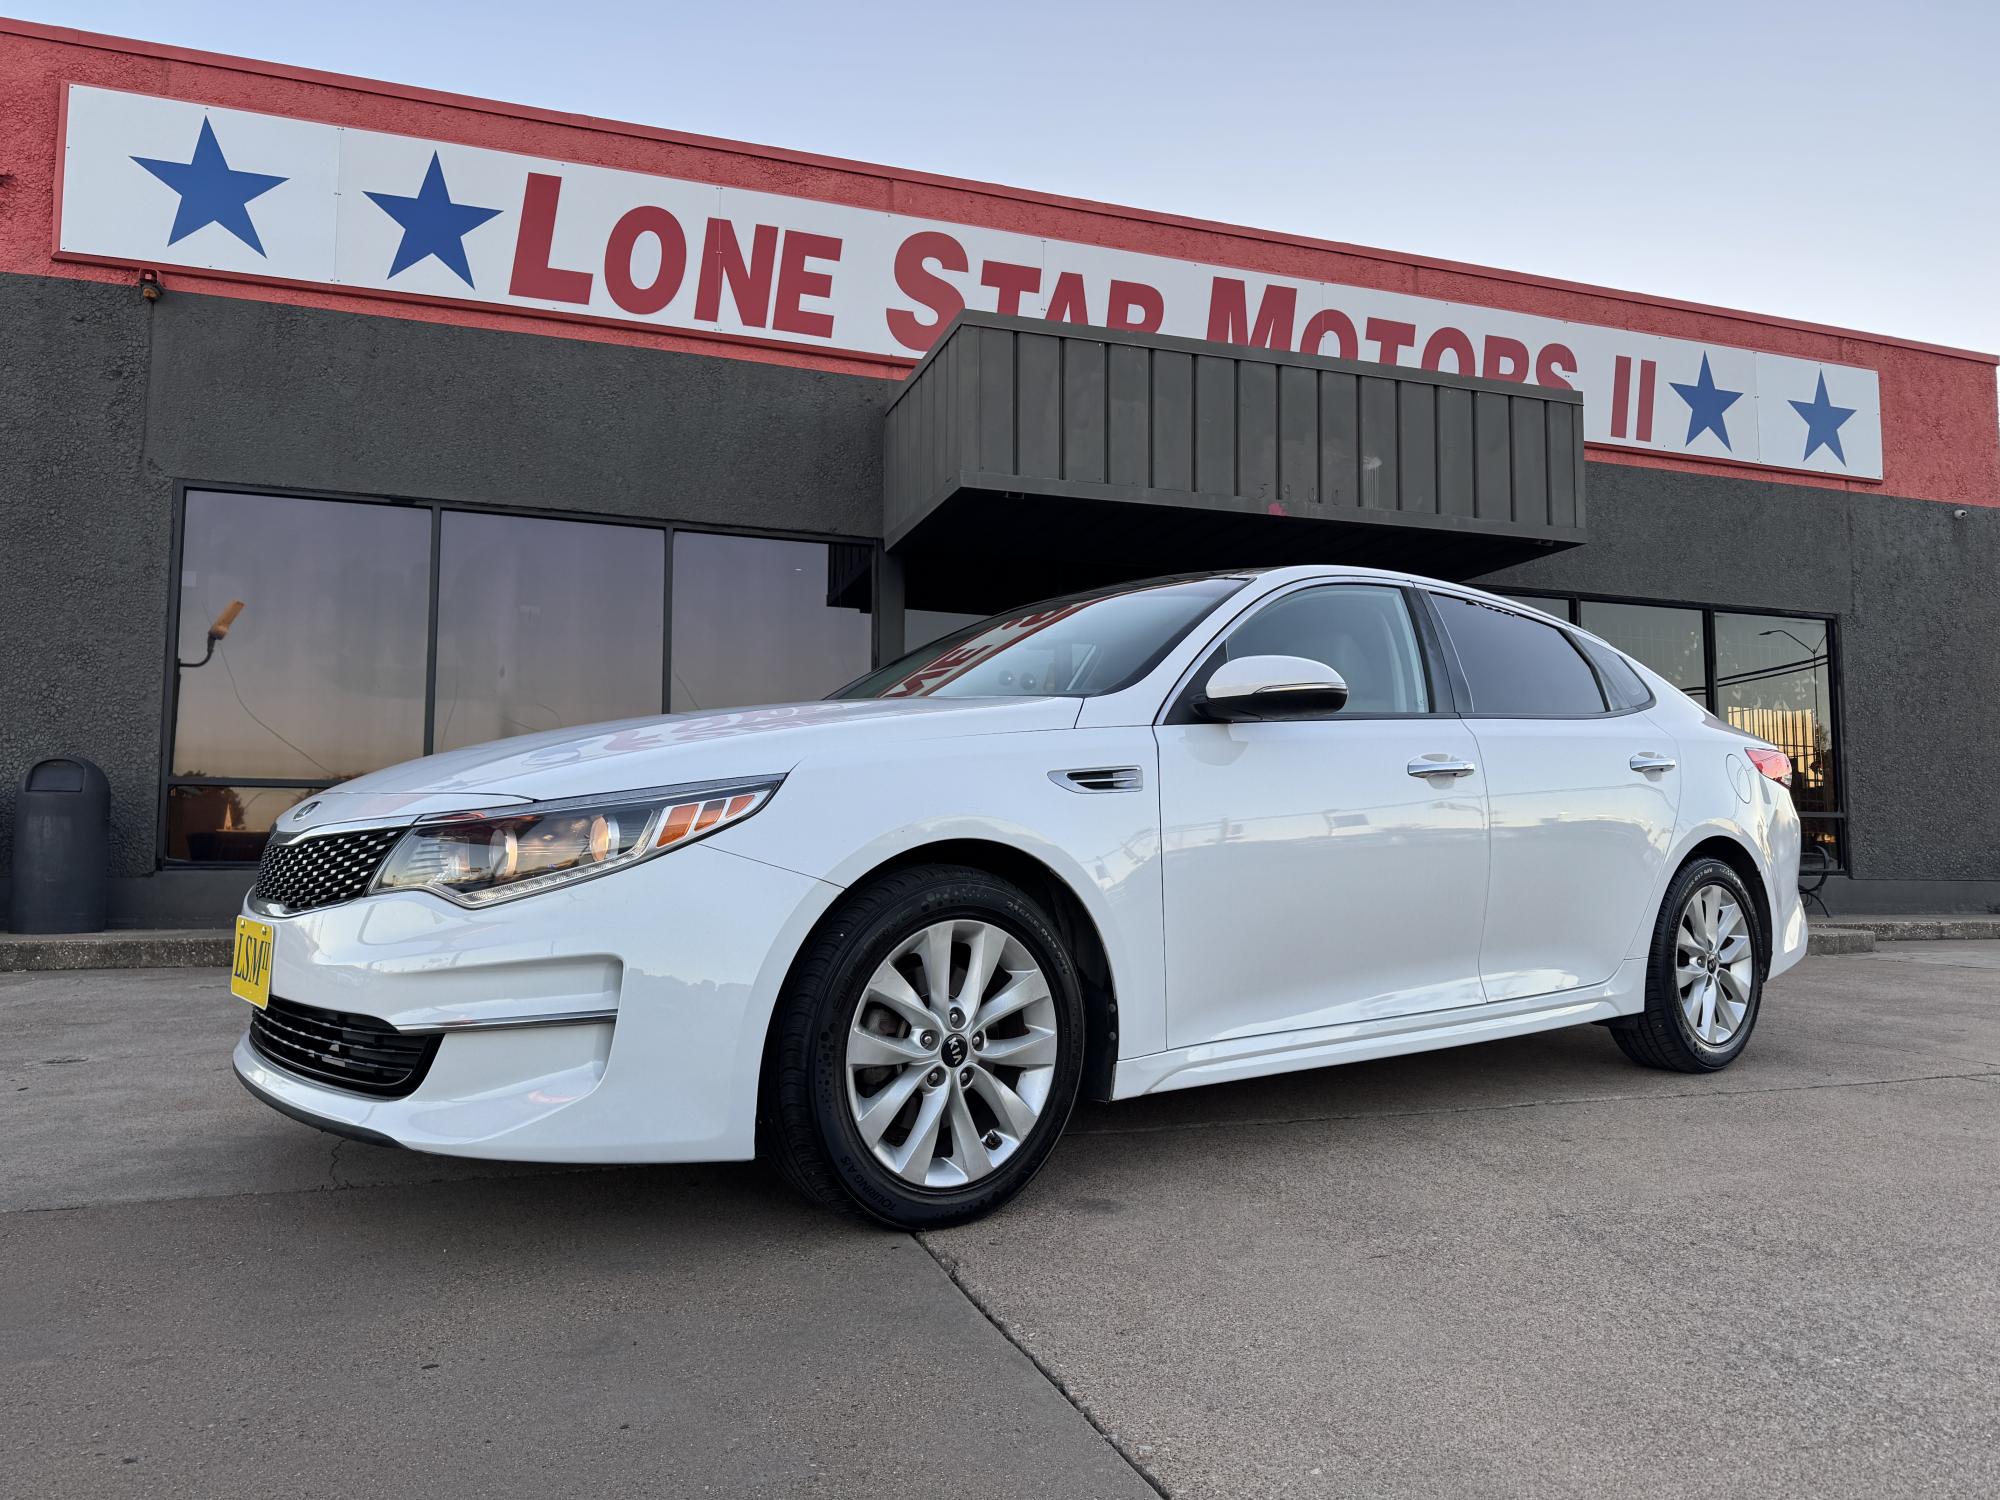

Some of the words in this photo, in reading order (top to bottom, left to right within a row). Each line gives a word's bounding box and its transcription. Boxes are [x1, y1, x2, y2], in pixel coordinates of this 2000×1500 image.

[508, 171, 843, 339] LONE
[885, 230, 1165, 352] STAR
[1205, 276, 1578, 392] MOTORS
[1610, 355, 1657, 443] II
